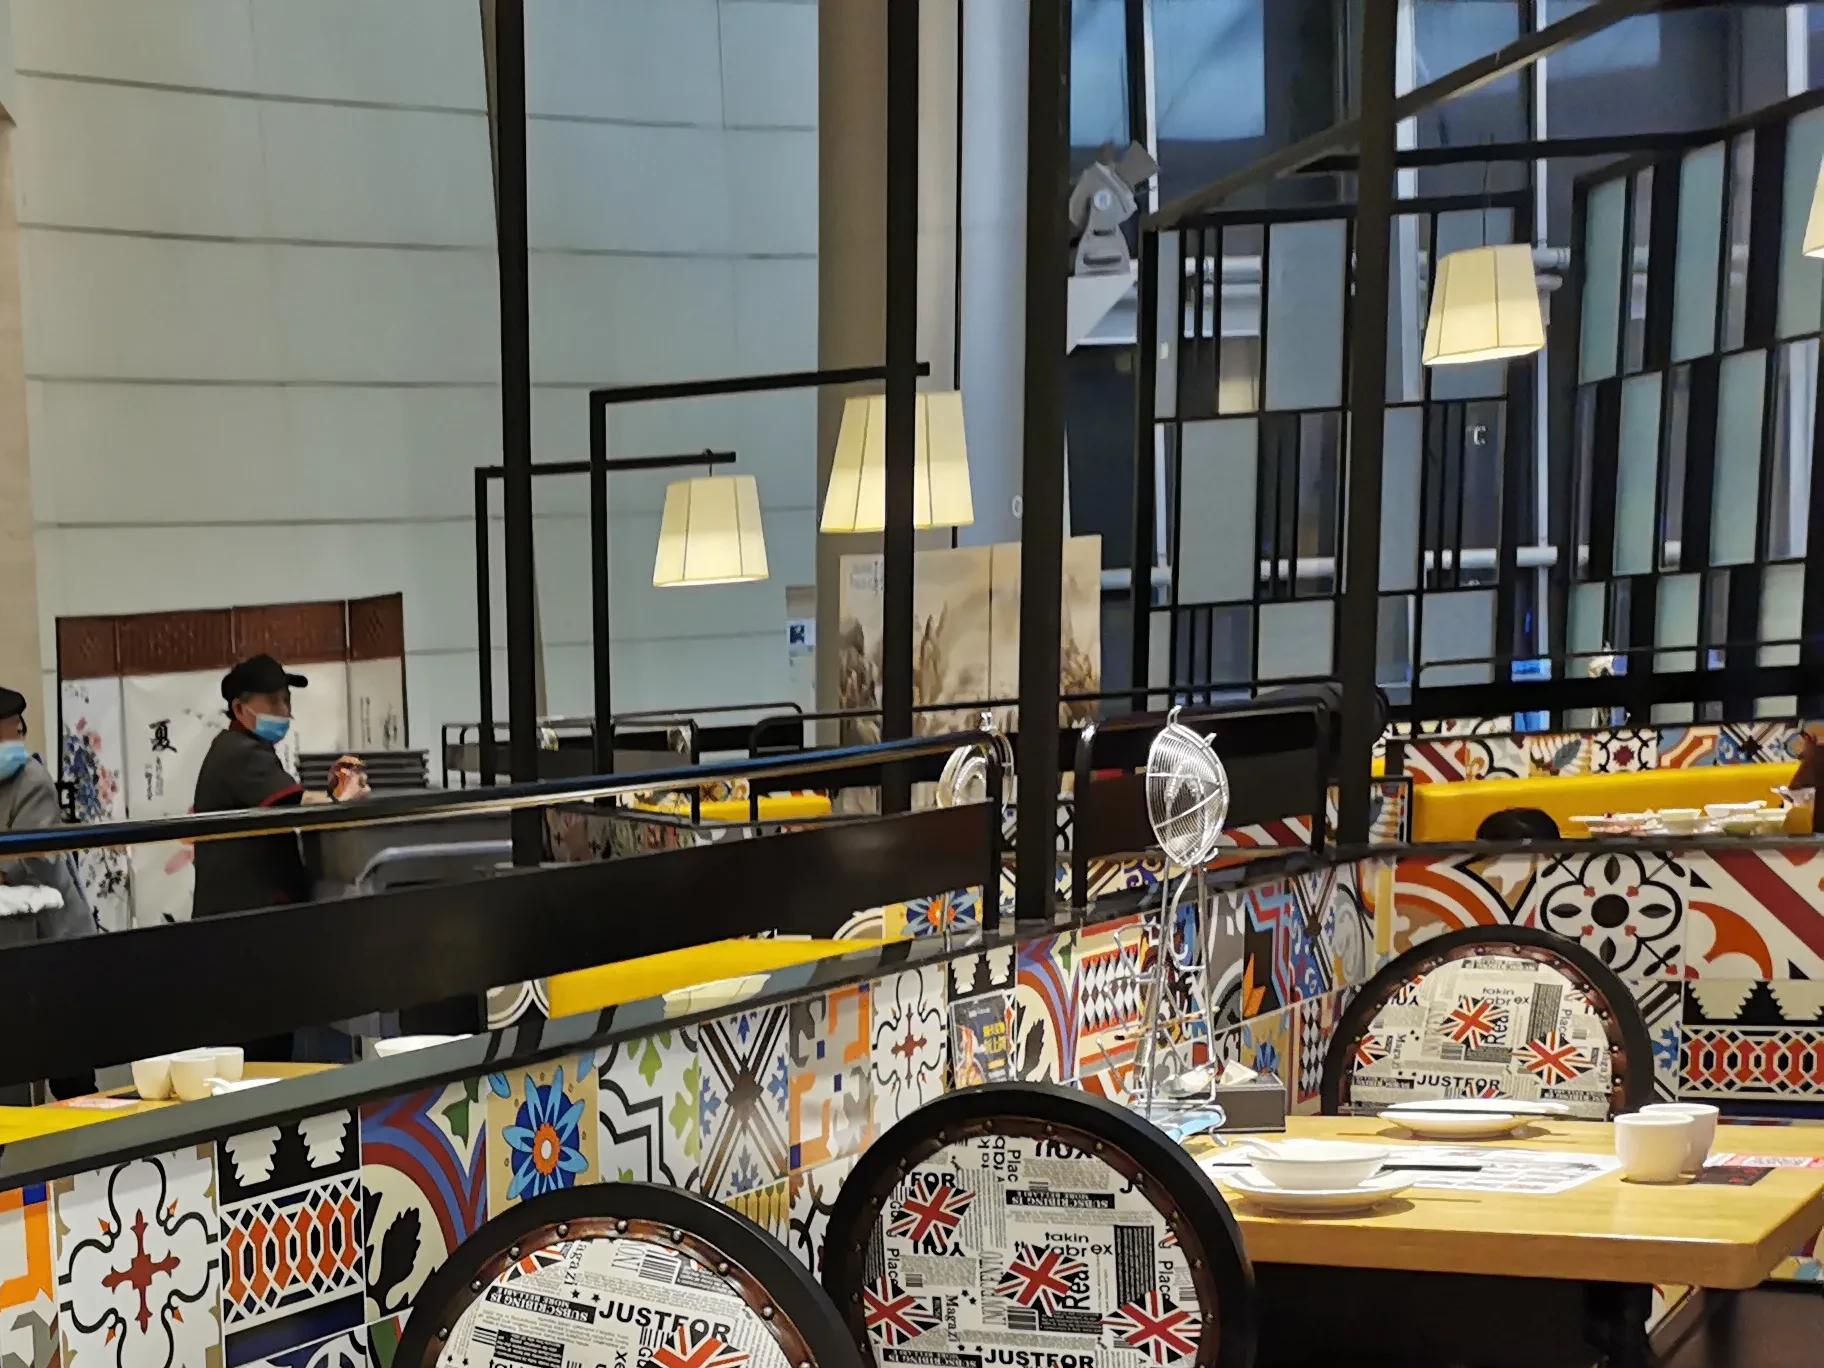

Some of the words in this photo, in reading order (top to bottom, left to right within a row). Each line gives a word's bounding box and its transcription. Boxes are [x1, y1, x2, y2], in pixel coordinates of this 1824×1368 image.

[1417, 1074, 1500, 1090] JUSTFOR
[1044, 1231, 1089, 1243] takin
[599, 1300, 731, 1344] JUSTFOR
